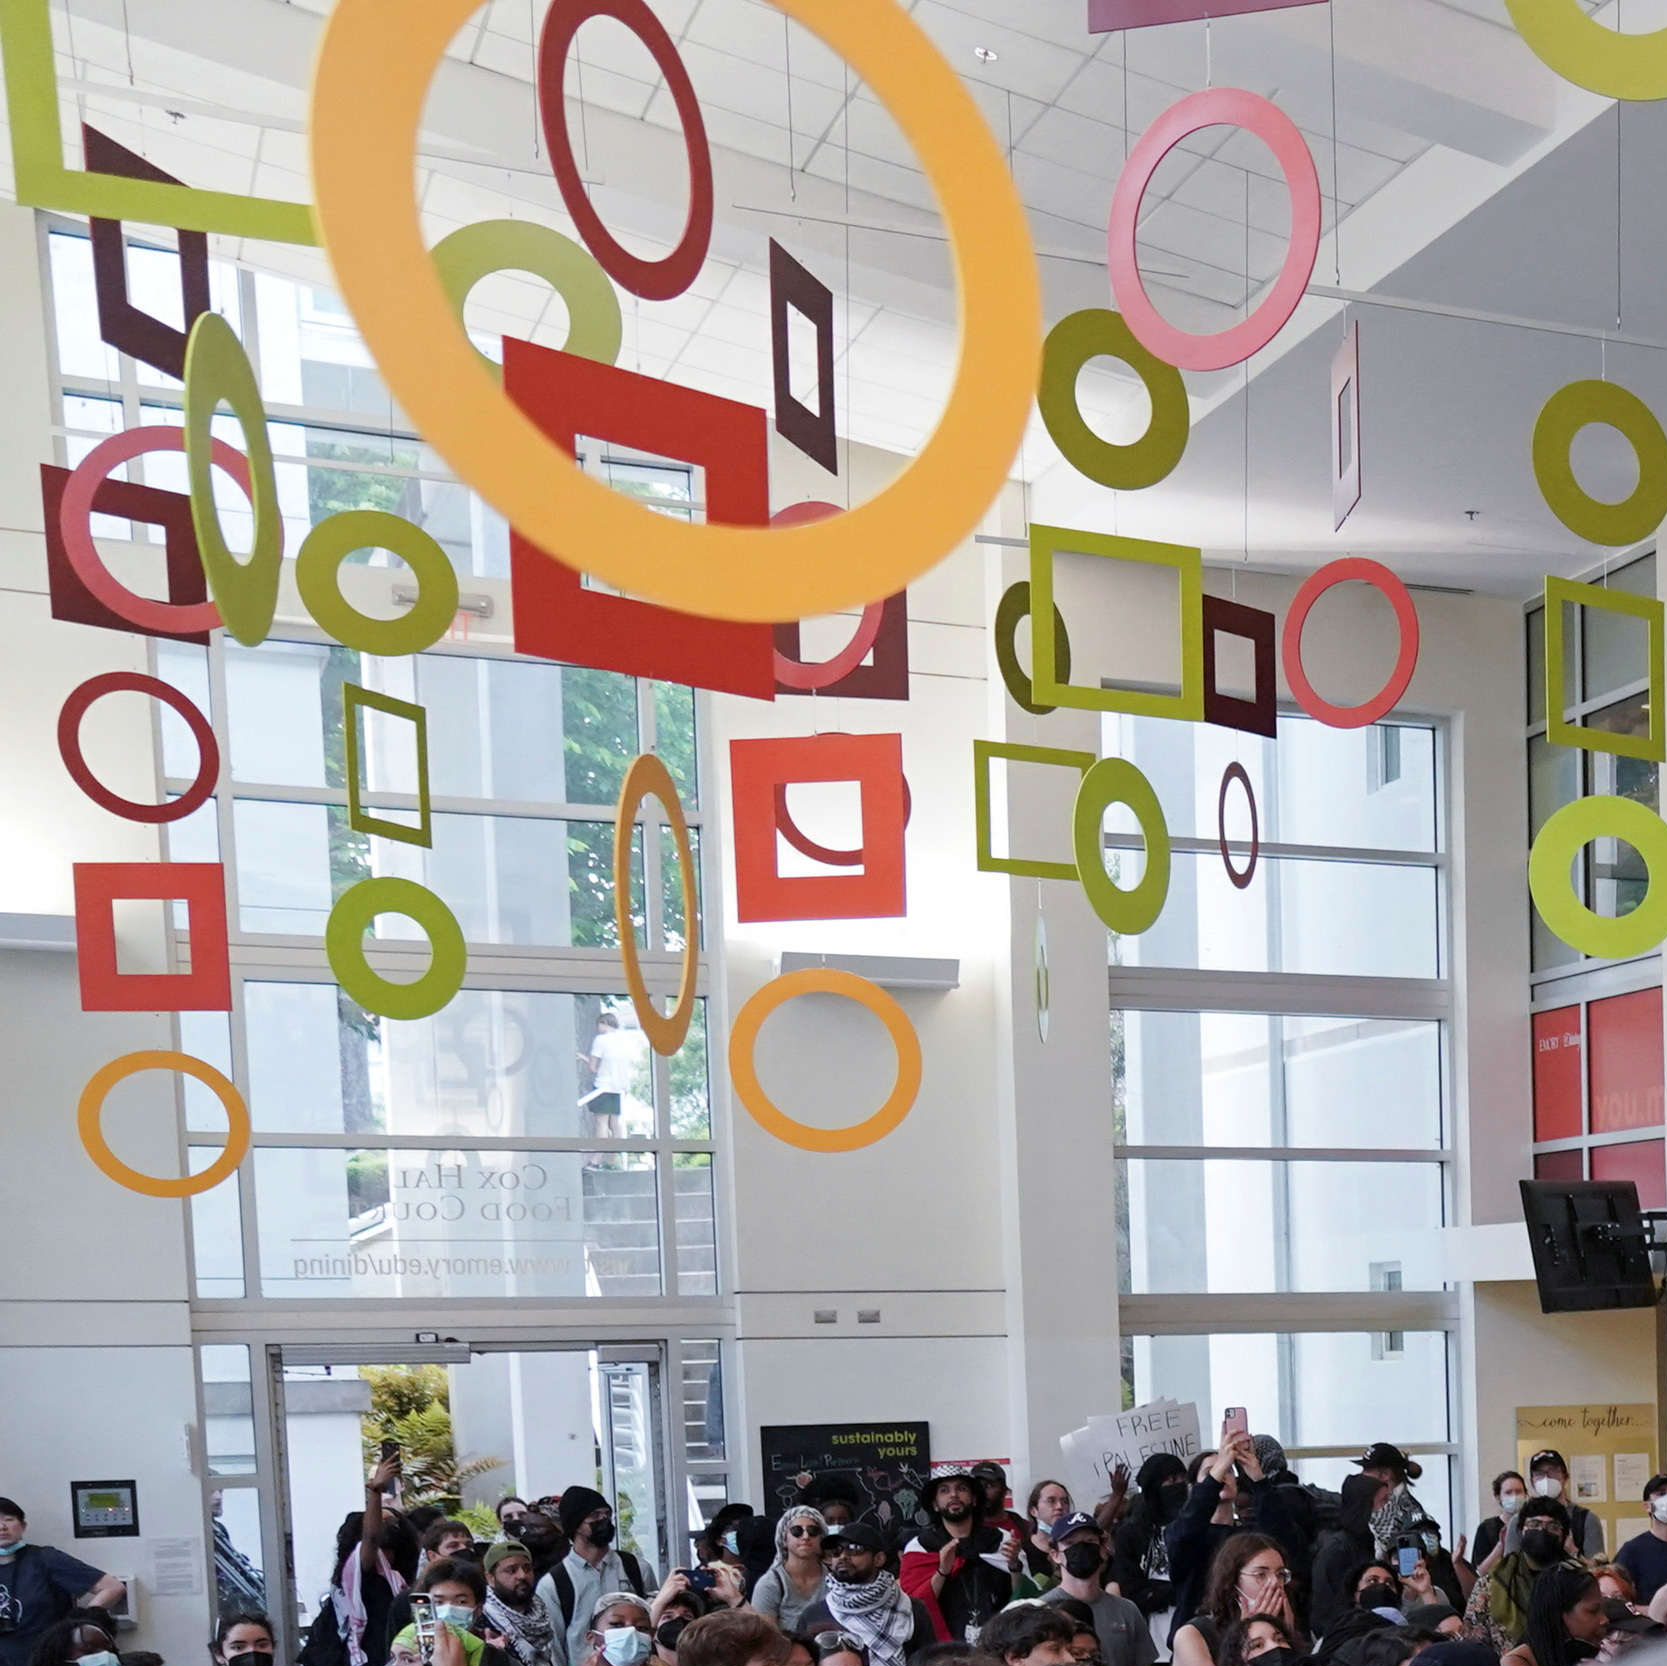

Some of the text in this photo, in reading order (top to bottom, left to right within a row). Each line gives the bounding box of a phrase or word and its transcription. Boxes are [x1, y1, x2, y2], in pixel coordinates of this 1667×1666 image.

[1116, 1408, 1180, 1438] FREE
[832, 1431, 917, 1445] sustainably
[877, 1445, 918, 1459] yours
